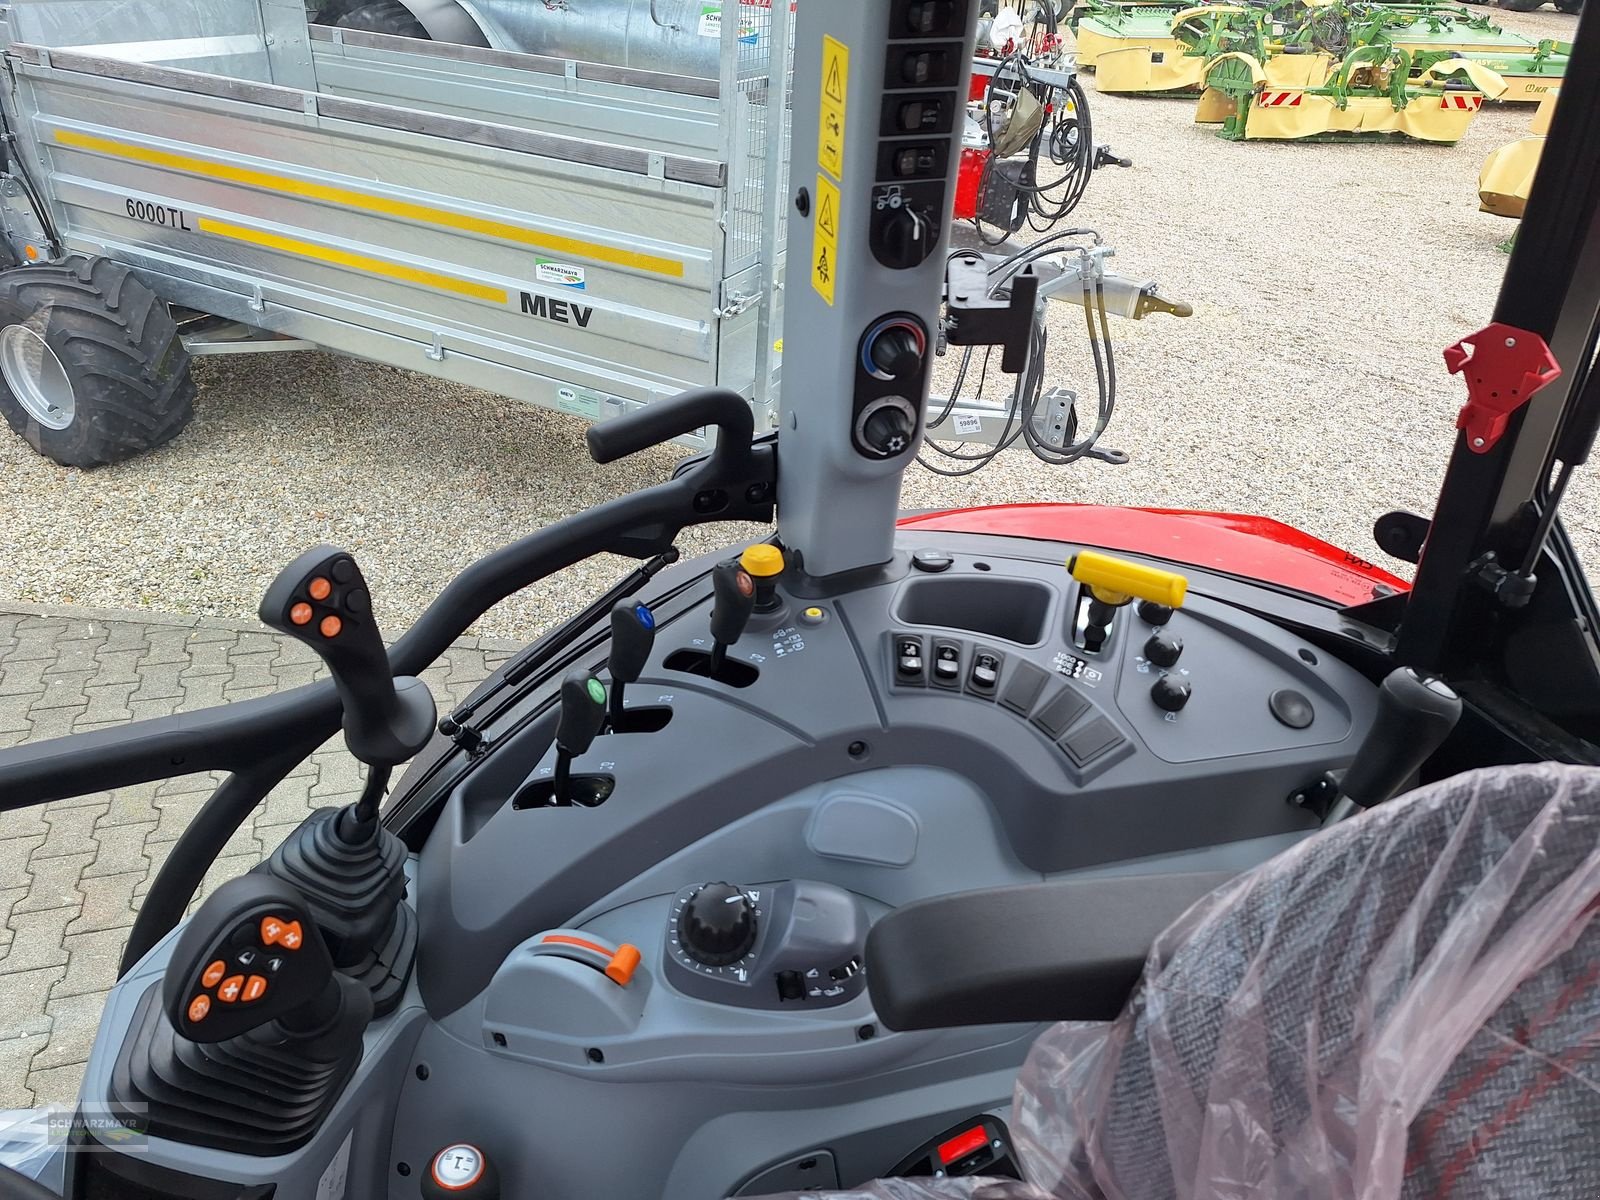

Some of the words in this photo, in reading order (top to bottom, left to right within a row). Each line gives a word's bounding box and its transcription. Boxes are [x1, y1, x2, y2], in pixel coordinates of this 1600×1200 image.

[126, 198, 191, 231] 6000TL
[540, 264, 578, 276] SCHWARZMAYR
[520, 291, 593, 328] MEV
[560, 390, 573, 398] MEV
[1057, 651, 1076, 664] 1000
